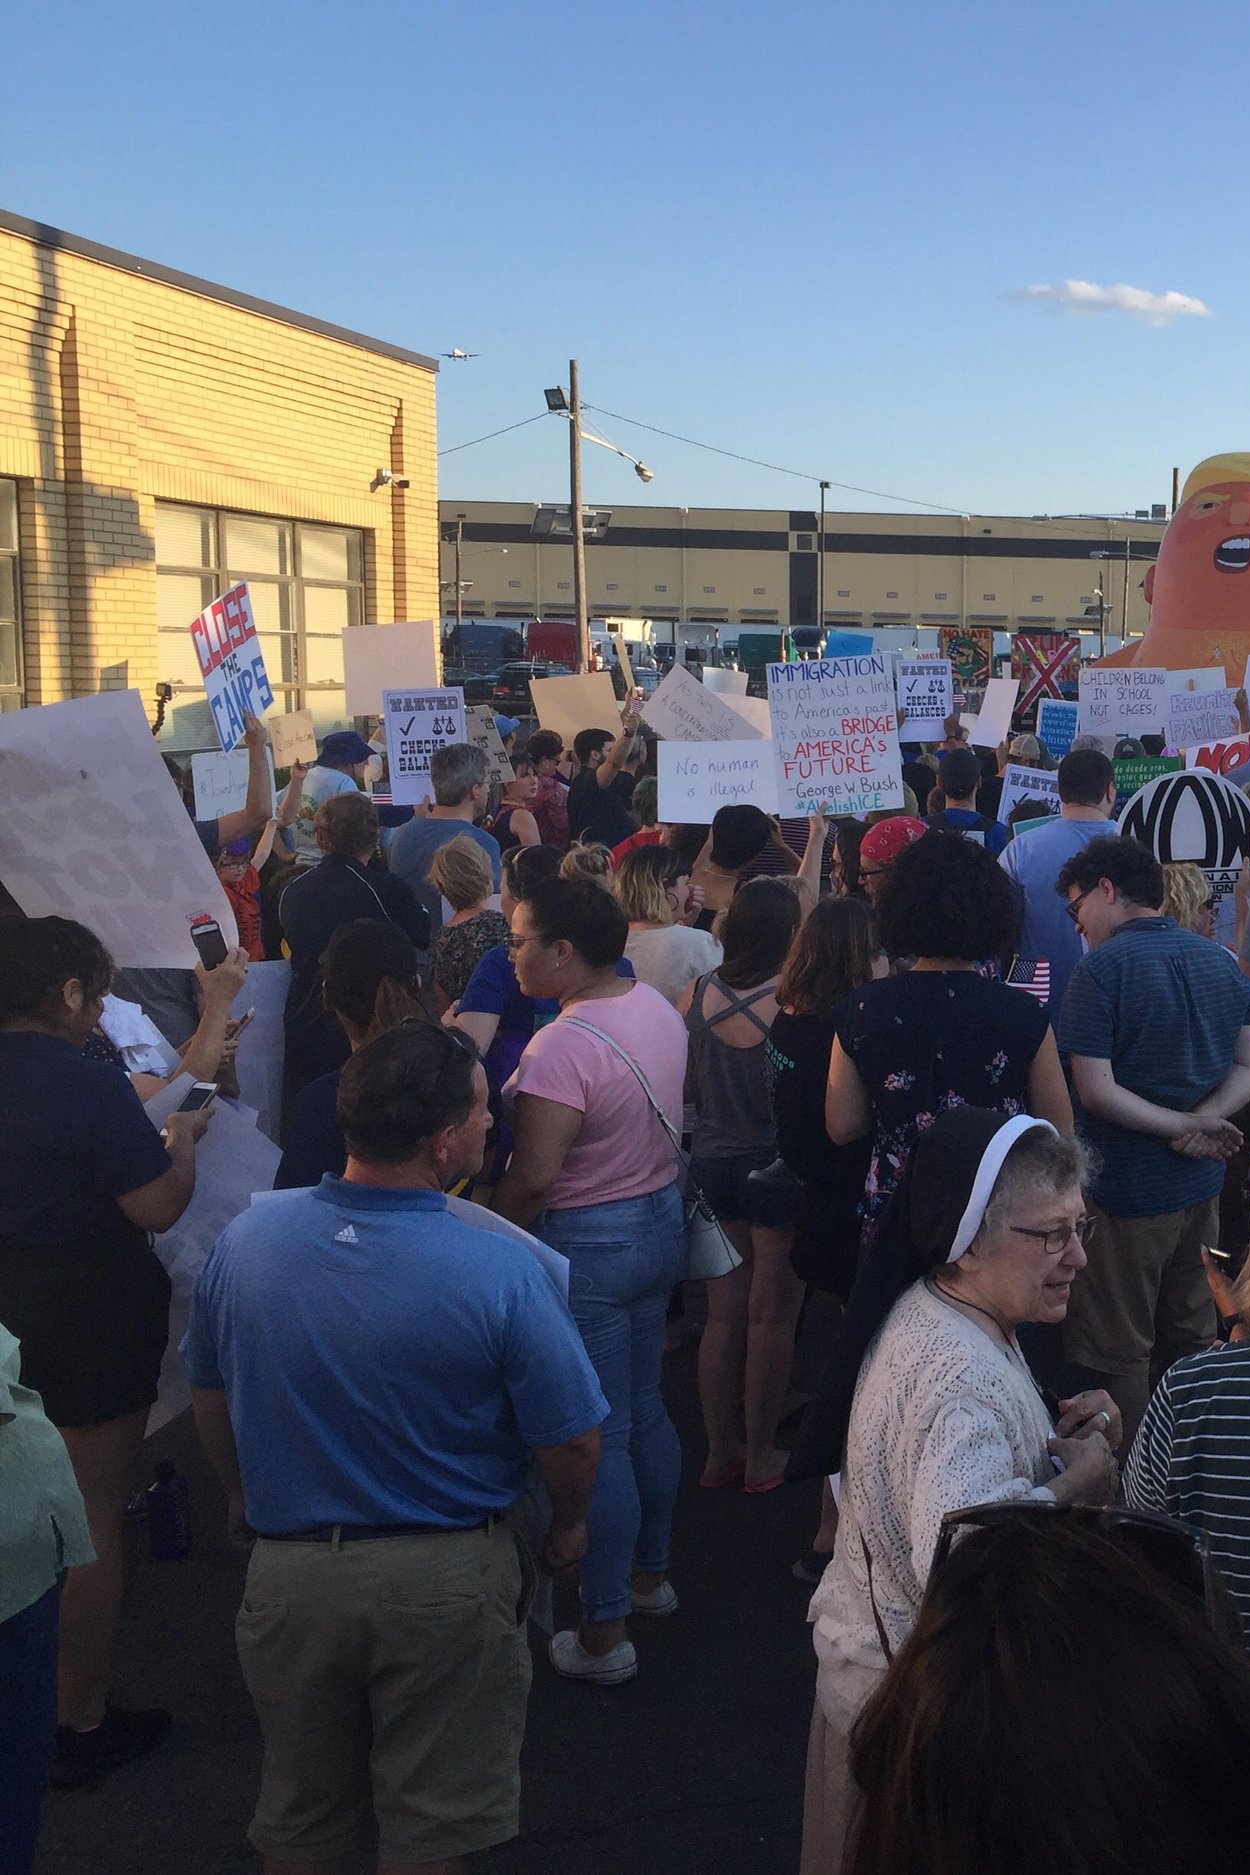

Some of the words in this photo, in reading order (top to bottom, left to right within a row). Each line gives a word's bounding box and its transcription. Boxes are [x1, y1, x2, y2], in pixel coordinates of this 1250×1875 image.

[190, 583, 256, 678] CLOSE
[220, 653, 241, 682] THE
[771, 655, 885, 684] IMMIGRATION
[788, 685, 811, 700] not
[821, 683, 850, 699] just
[856, 685, 866, 694] a
[871, 675, 893, 693] link
[1134, 671, 1165, 685] BELONG
[1094, 688, 1107, 700] IN
[1116, 687, 1153, 701] SCHOOL
[211, 656, 274, 753] CAMPS
[773, 706, 788, 720] to
[794, 703, 860, 720] America's
[1090, 705, 1109, 717] NOT
[1119, 704, 1158, 716] CAGES!
[801, 724, 826, 739] also
[829, 727, 838, 736] a
[841, 715, 896, 736] BRIDGE
[777, 744, 791, 760] to
[399, 757, 431, 771] BALA
[676, 757, 699, 776] No
[708, 758, 760, 773] human
[687, 787, 695, 798] is
[710, 780, 754, 799] illegal
[859, 774, 898, 793] Bush
[1010, 772, 1059, 794] WANTE
